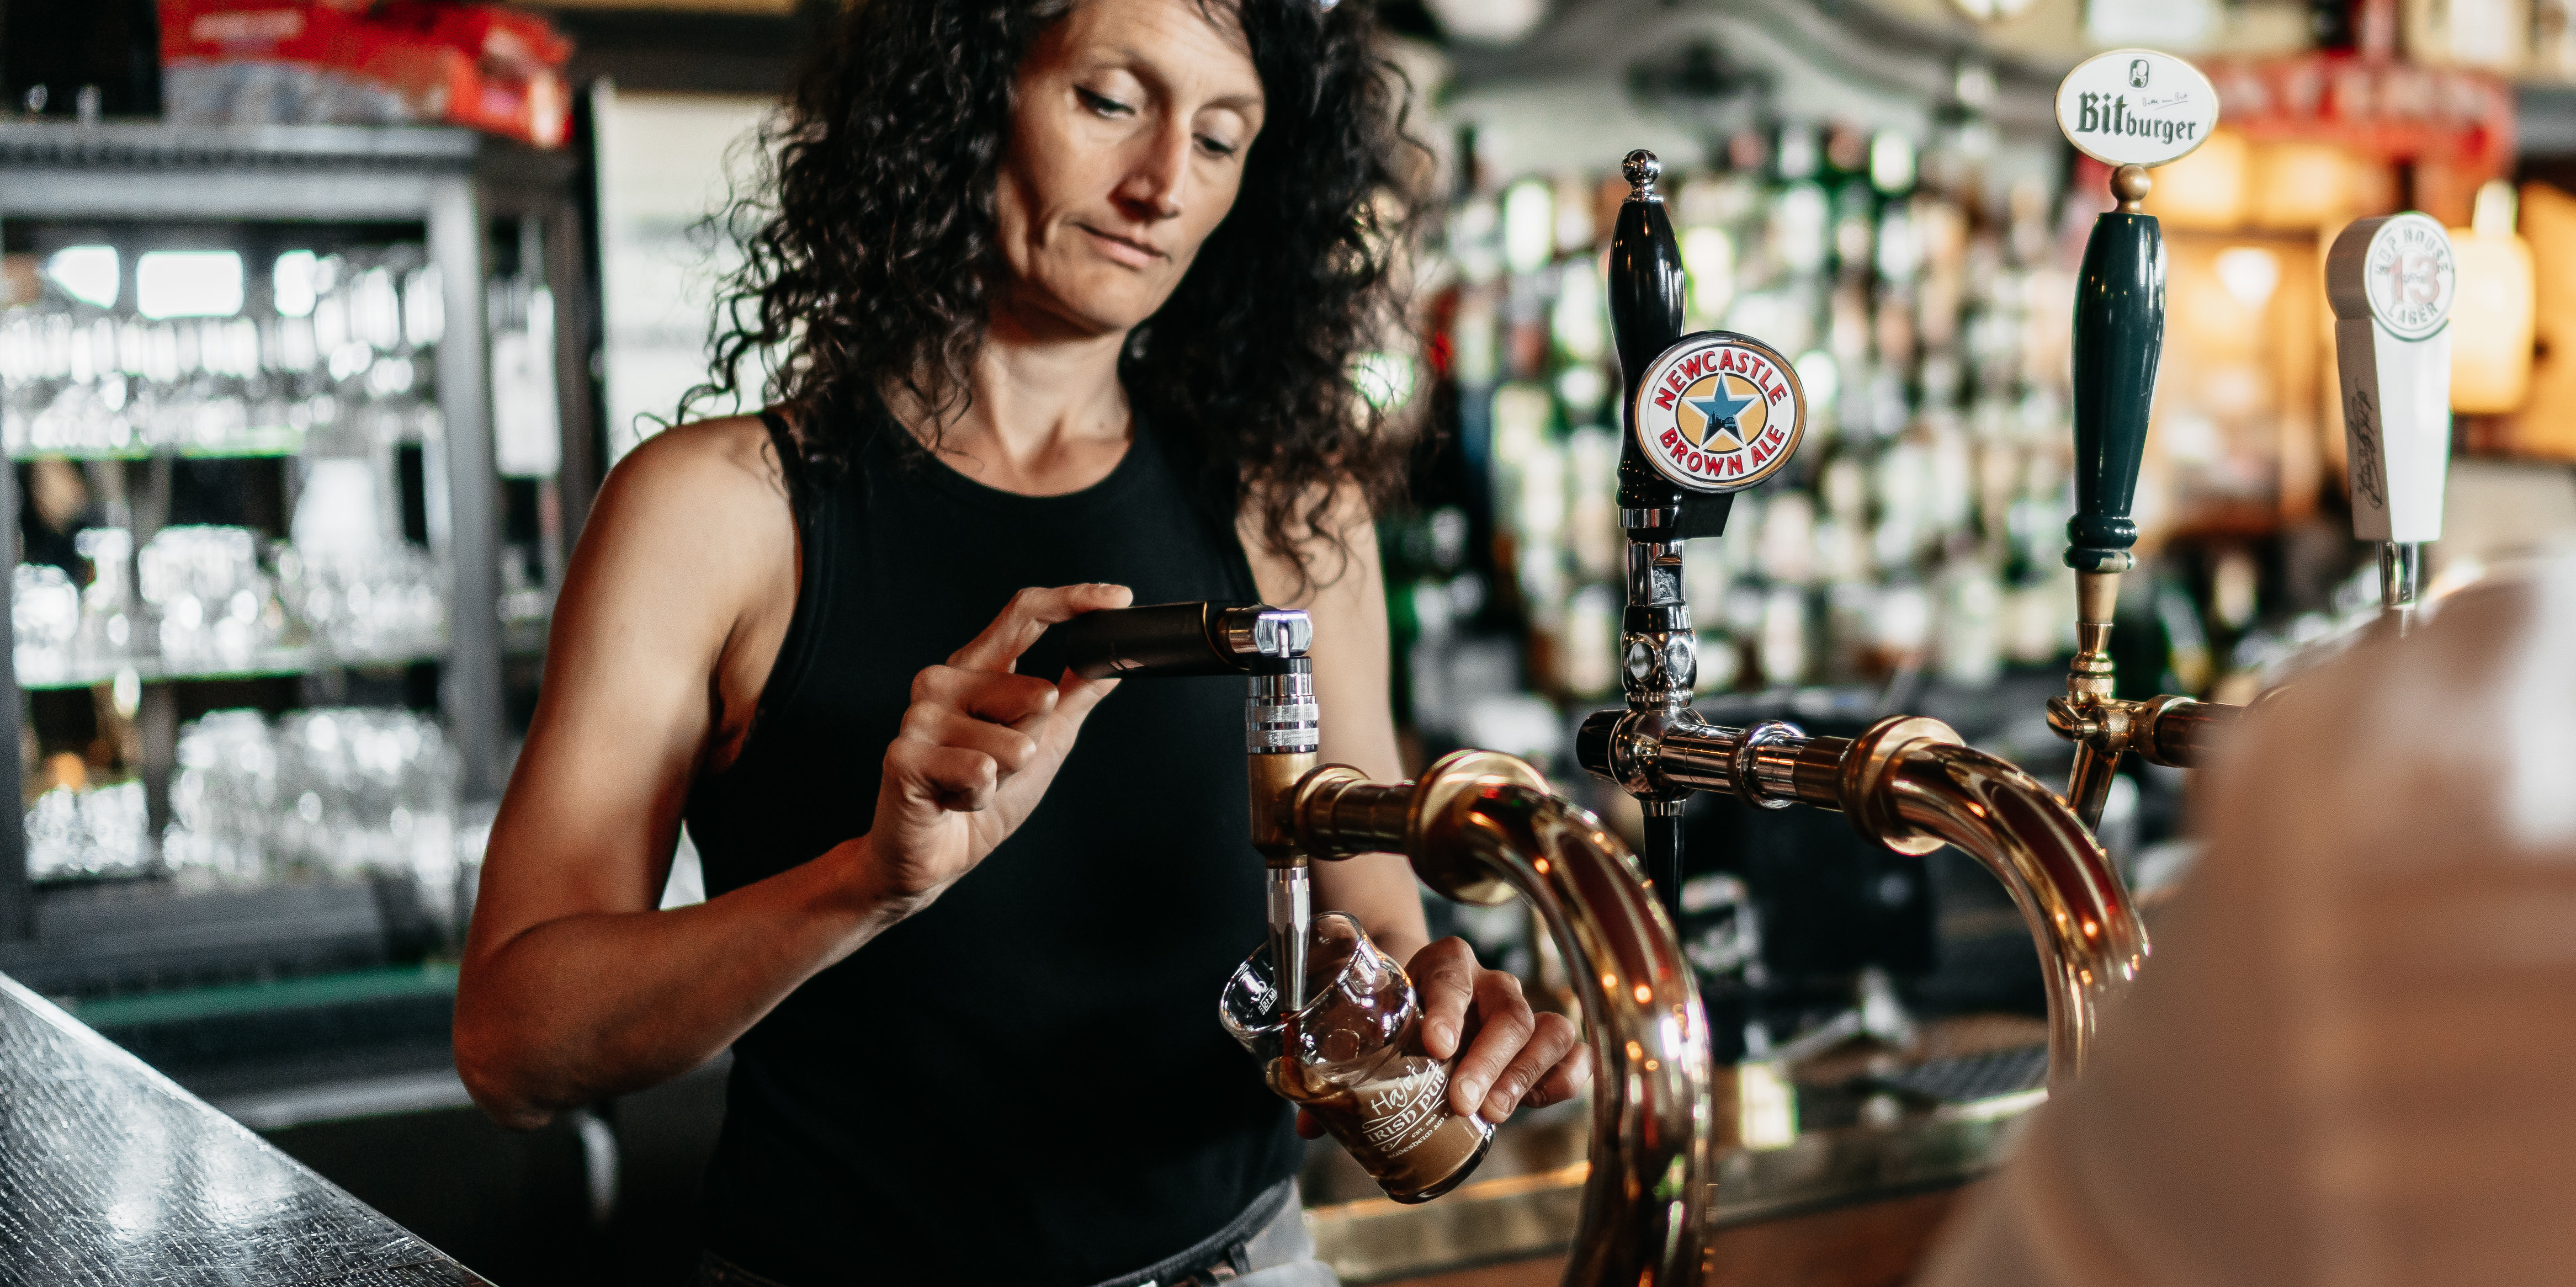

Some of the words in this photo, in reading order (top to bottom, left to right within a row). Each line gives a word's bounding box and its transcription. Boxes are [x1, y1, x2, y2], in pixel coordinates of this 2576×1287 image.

[2075, 91, 2197, 145] Bitburger
[2375, 236, 2396, 275] HOP
[2403, 228, 2448, 273] HOUSE
[2389, 254, 2440, 305] 13
[2388, 301, 2439, 325] LAGER
[1654, 349, 1787, 411] NEWCASTLE
[1660, 427, 1744, 477] BROWN
[1750, 424, 1785, 467] ALE
[1371, 1065, 1420, 1115] Hajo's
